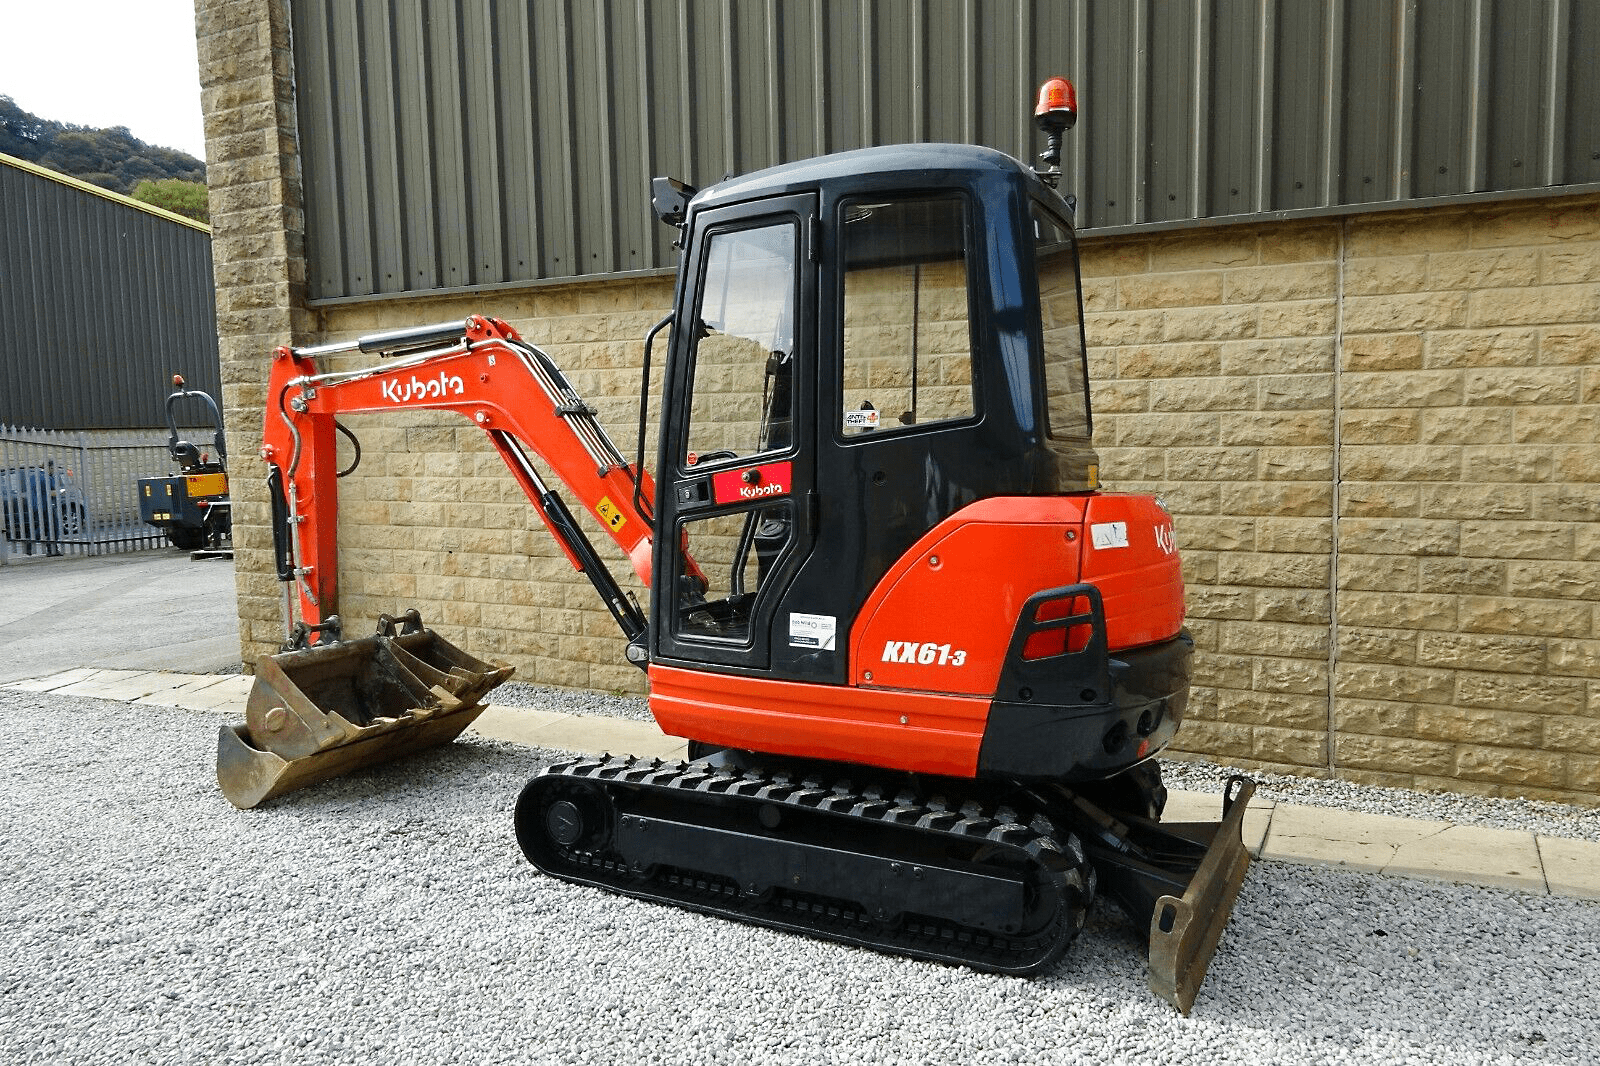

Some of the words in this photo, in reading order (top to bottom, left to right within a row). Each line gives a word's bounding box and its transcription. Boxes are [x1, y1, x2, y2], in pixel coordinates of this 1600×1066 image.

[382, 371, 464, 402] Kubota
[740, 483, 782, 497] Kubota
[881, 640, 967, 666] KX61-3
